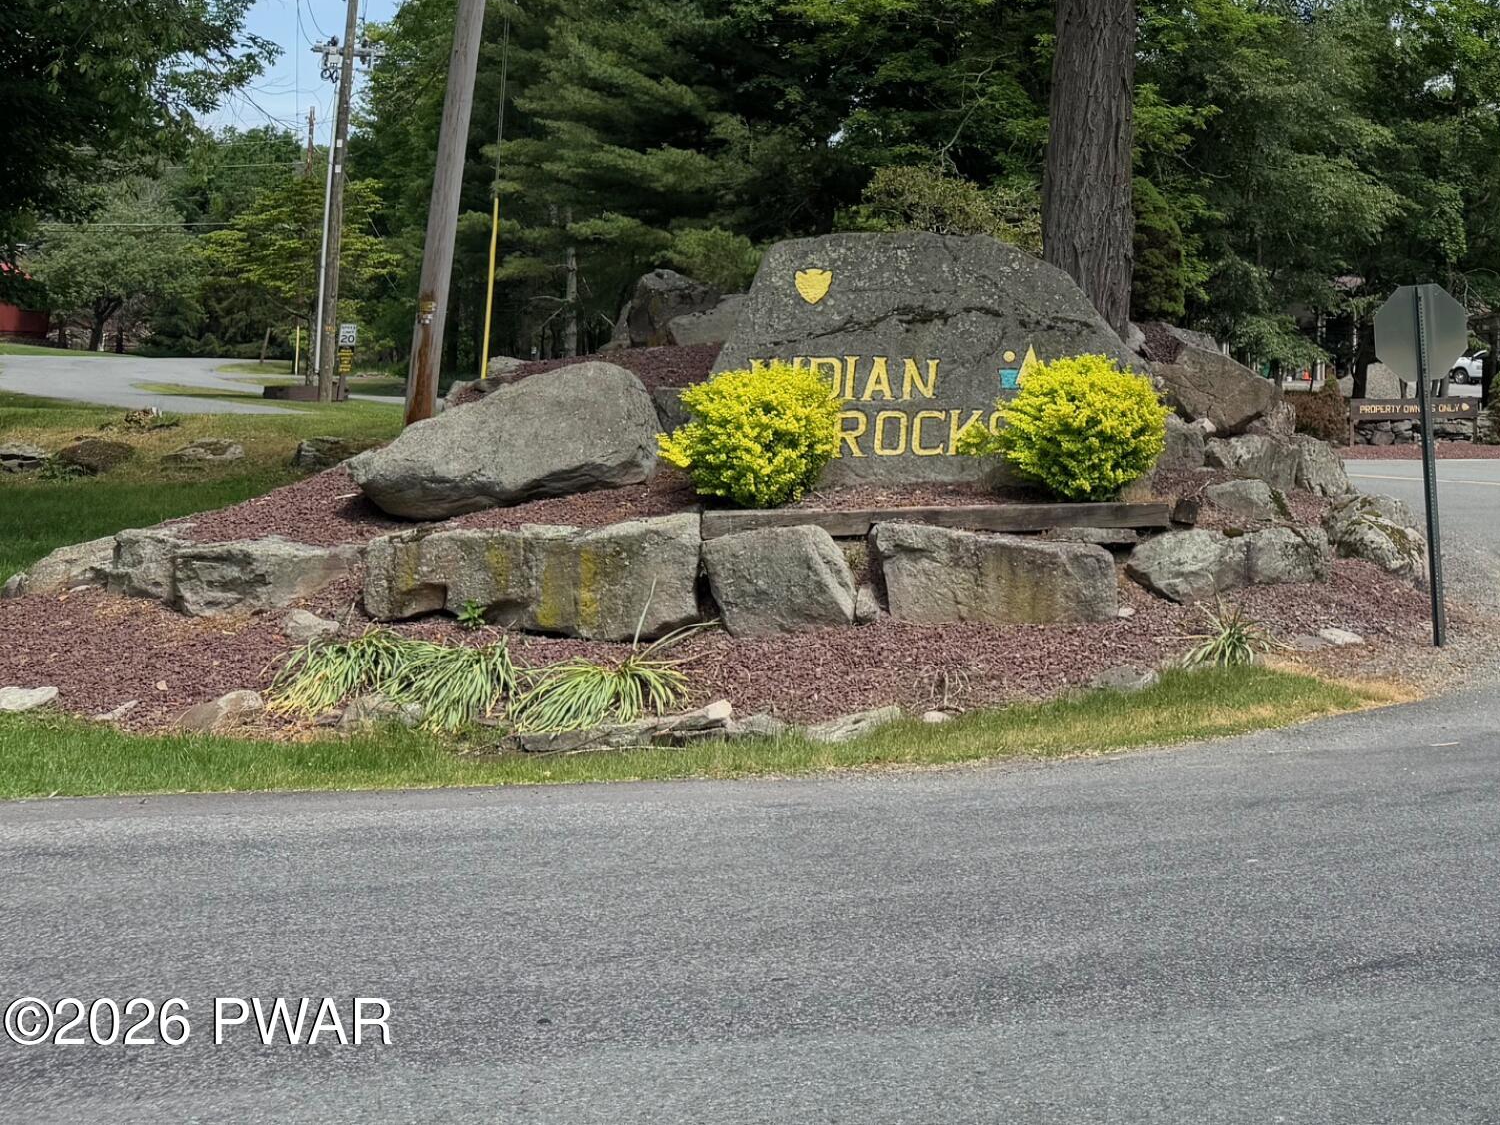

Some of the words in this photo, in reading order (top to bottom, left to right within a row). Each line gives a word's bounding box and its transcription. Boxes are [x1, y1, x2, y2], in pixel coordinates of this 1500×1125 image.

[340, 334, 355, 343] 20
[748, 355, 940, 401] DIAN
[1360, 404, 1401, 414] PROPERTY
[1403, 403, 1437, 414] OWNS
[1438, 402, 1460, 413] ONLY
